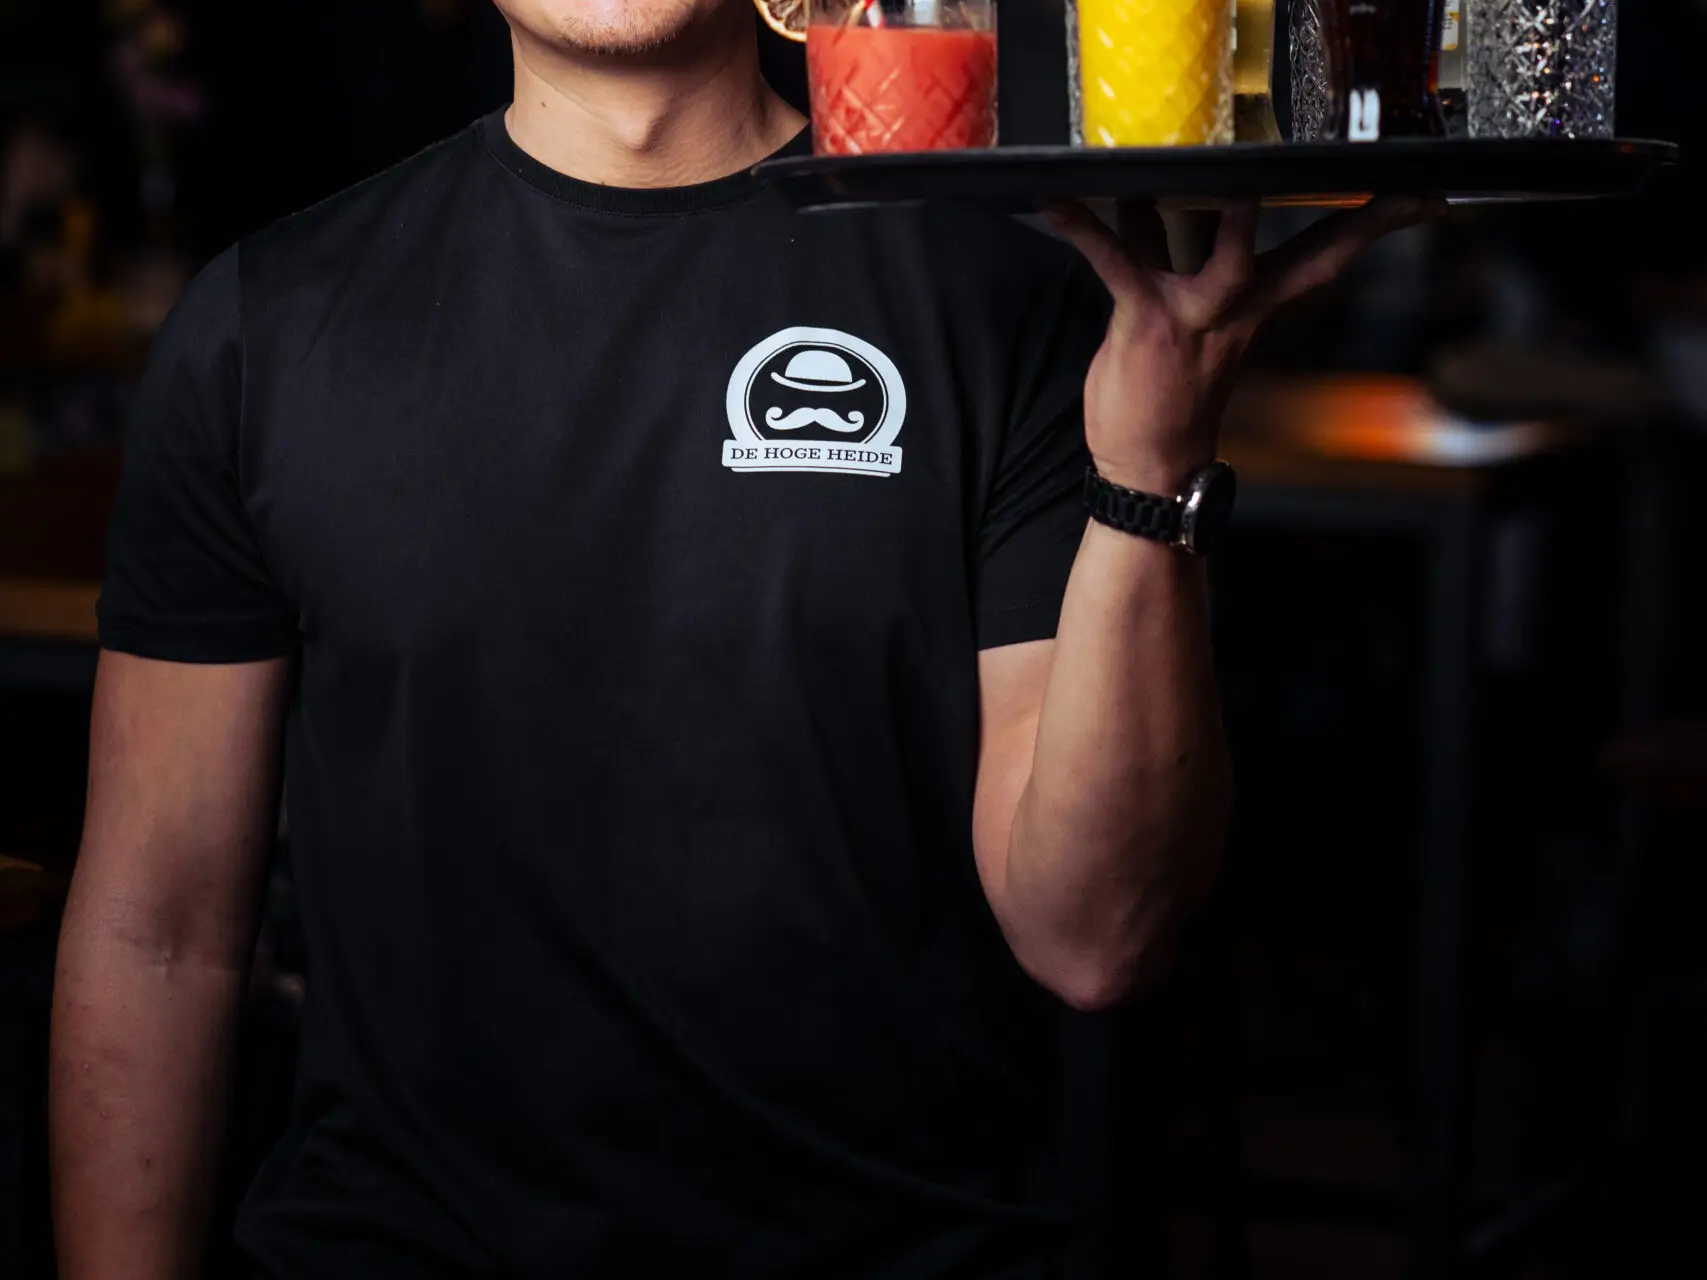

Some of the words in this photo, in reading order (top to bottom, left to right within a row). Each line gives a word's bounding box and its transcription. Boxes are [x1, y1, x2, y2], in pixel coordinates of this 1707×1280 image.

[731, 448, 758, 460] DE
[764, 447, 821, 460] HOGE
[827, 448, 894, 465] HEIDE
